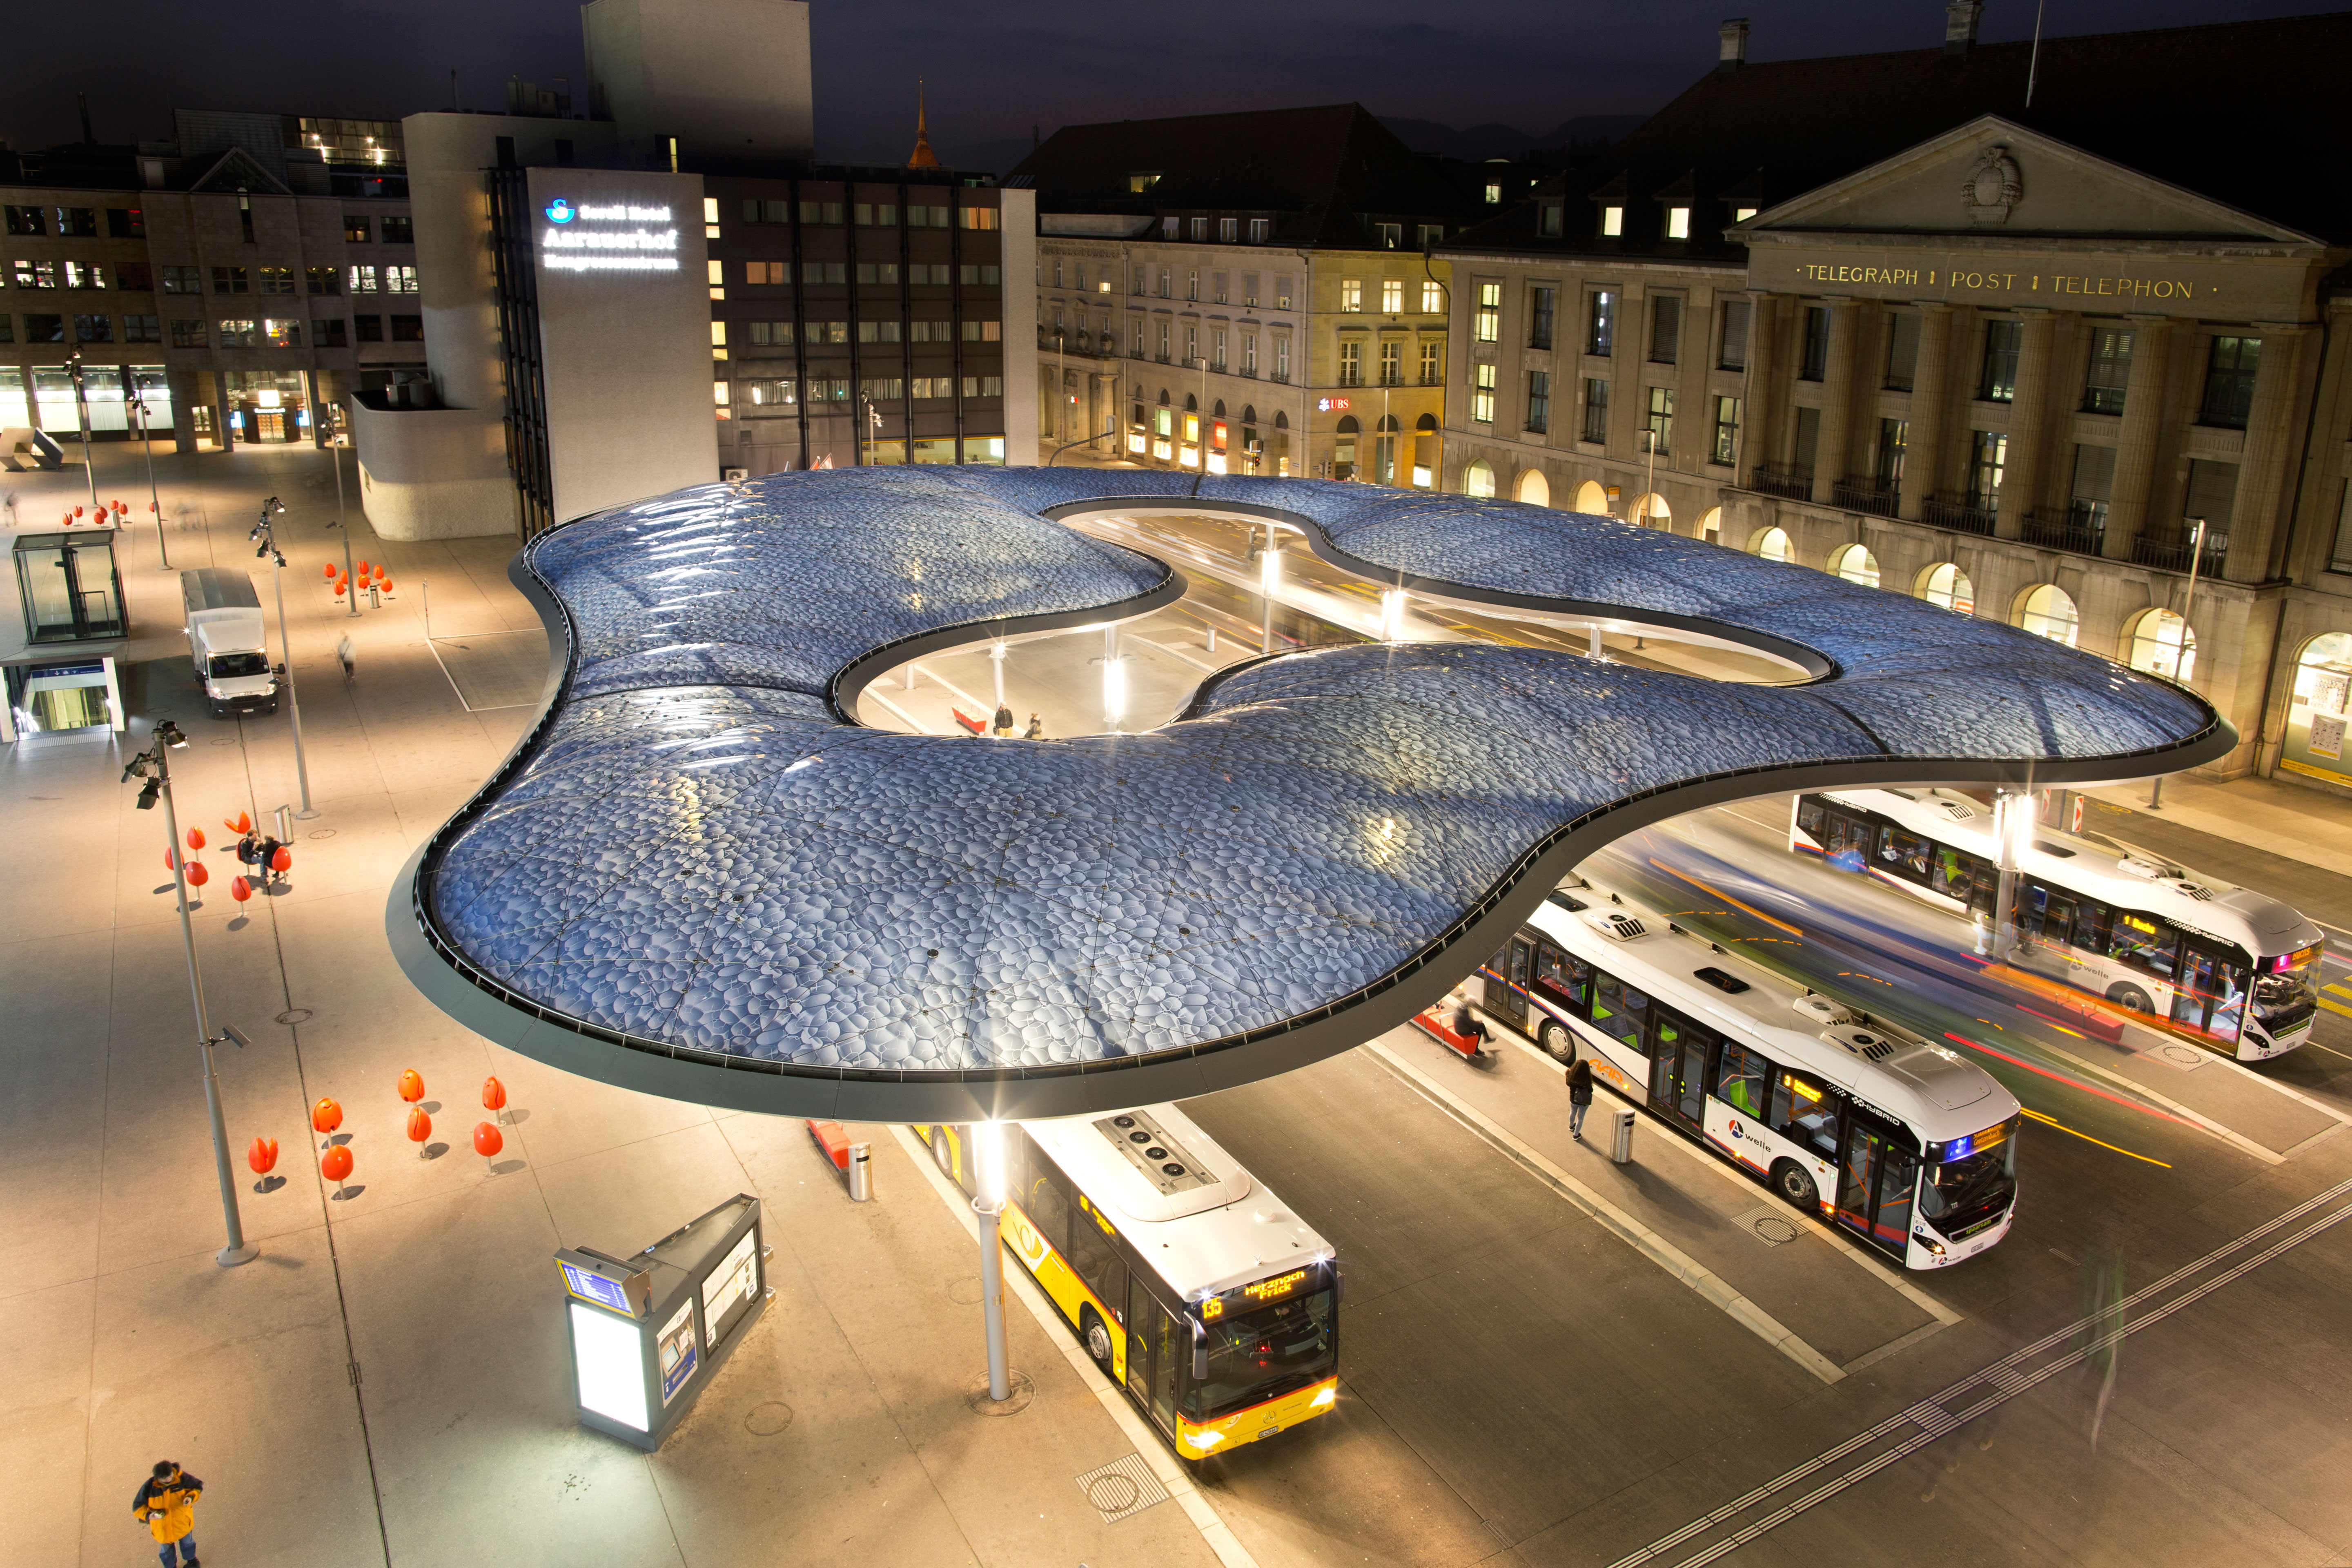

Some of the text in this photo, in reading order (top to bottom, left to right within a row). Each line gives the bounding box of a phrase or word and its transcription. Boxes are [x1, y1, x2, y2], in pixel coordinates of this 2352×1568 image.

[628, 207, 671, 221] Hotel
[543, 228, 677, 249] Aarauerhof
[1806, 265, 2193, 298] TELEGRAPH POST TELEPHON
[1331, 399, 1349, 409] UBS
[1842, 800, 1867, 813] HYBRID
[2124, 915, 2156, 934] 1 Buchs
[2198, 931, 2234, 947] HYBRID
[2084, 964, 2109, 980] welle
[1784, 1075, 1791, 1086] 3
[1861, 1101, 1900, 1126] HYBRID
[1745, 1133, 1771, 1152] welle
[1973, 1130, 2000, 1146] Gretzenbach
[1966, 1219, 1991, 1234] spaarsam
[1245, 1270, 1305, 1296] Herznach
[1259, 1282, 1292, 1300] Frick
[1202, 1296, 1222, 1319] 135
